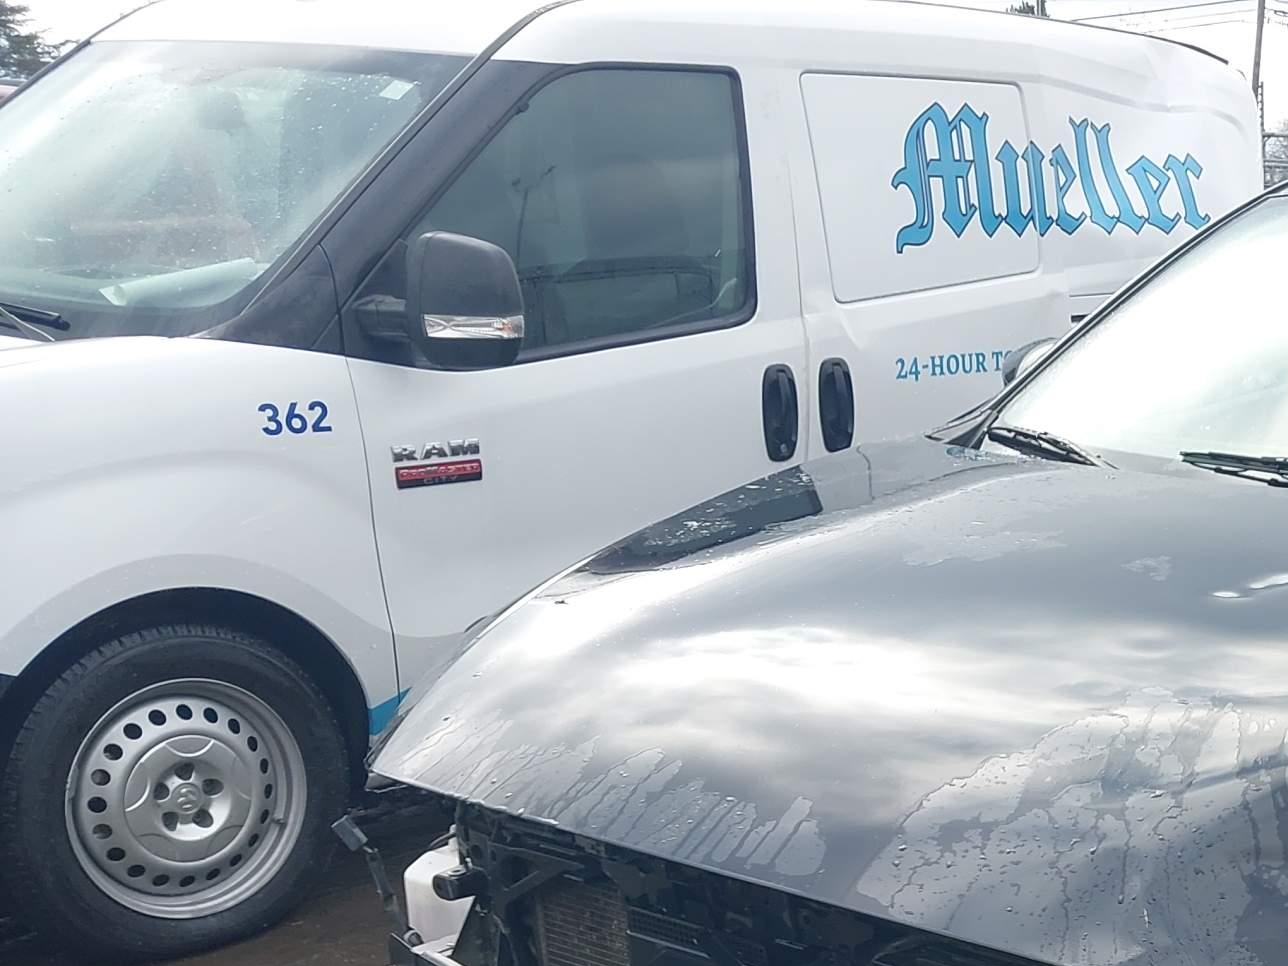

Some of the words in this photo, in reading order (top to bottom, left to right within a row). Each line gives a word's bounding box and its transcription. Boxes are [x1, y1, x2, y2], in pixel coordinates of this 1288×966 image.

[891, 102, 1211, 254] Mueller
[896, 353, 987, 381] 24-HOUR
[257, 400, 333, 436] 362
[391, 439, 480, 462] RAM
